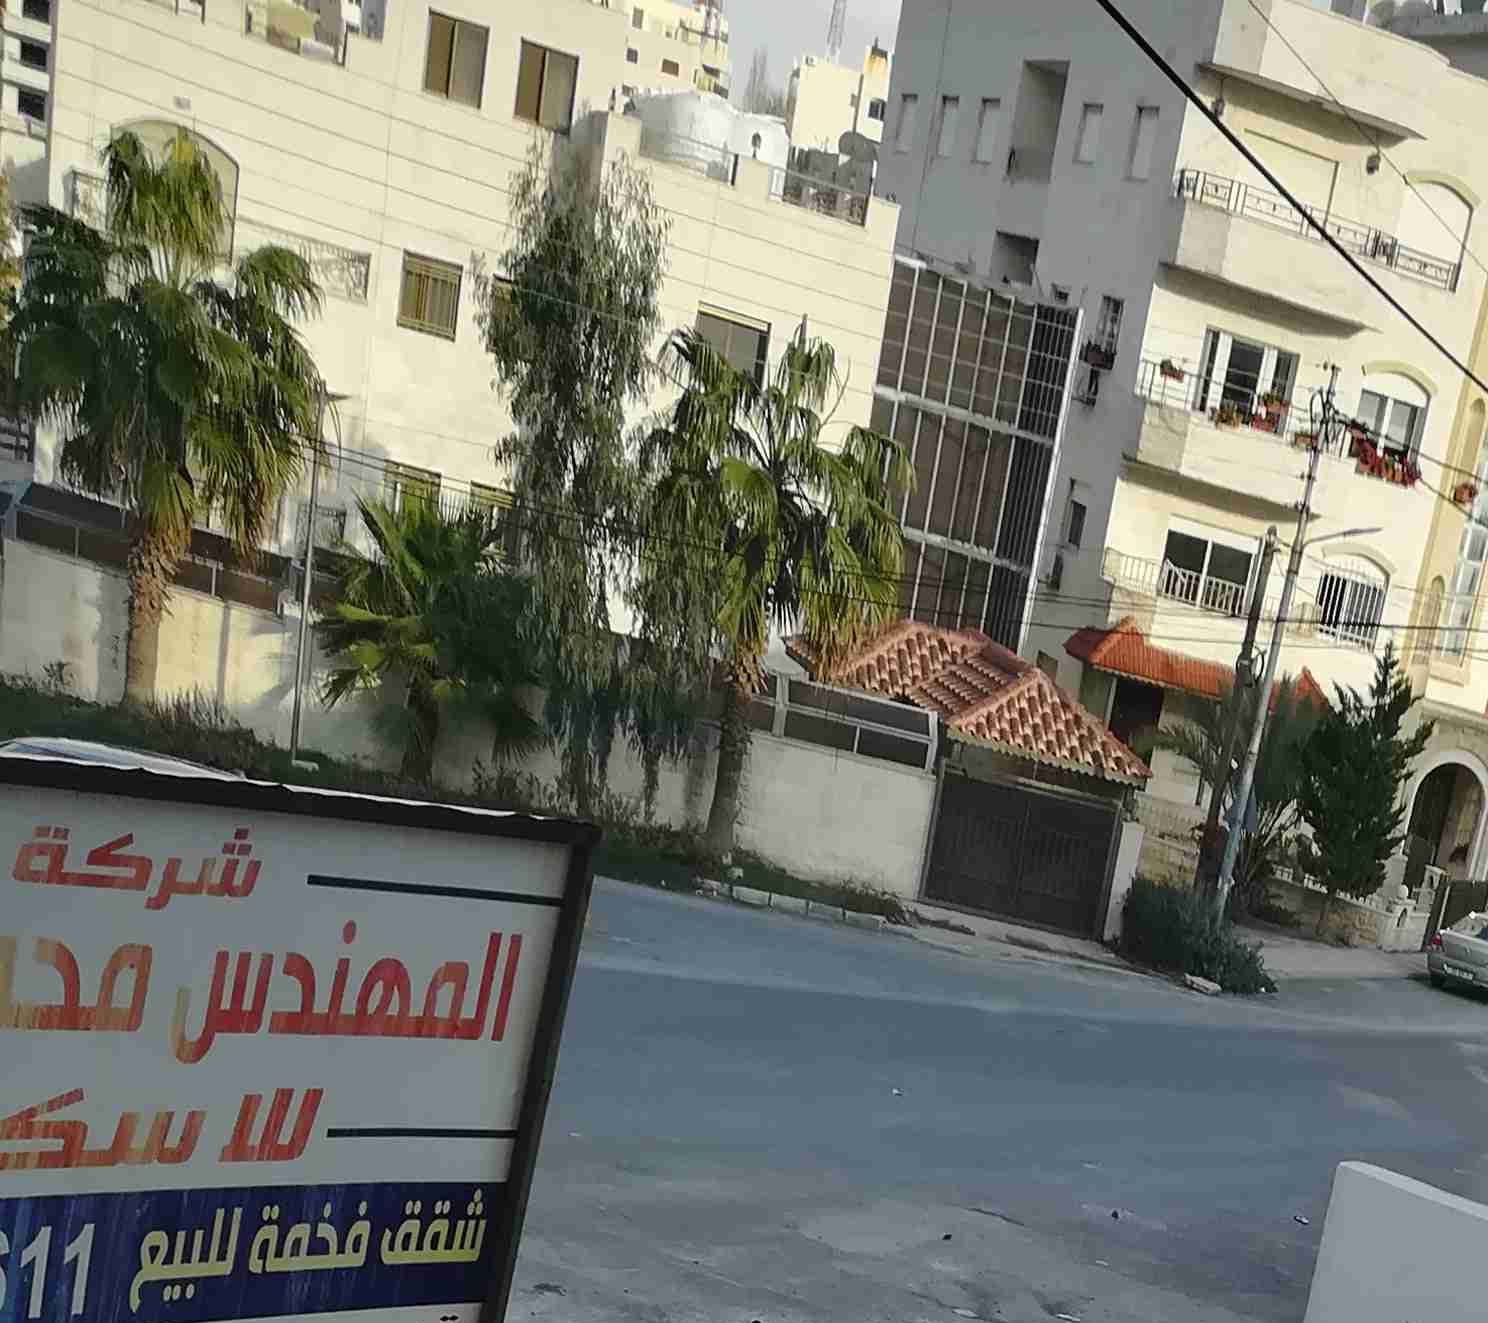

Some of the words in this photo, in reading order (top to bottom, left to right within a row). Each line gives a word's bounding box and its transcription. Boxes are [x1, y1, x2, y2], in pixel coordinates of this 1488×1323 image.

[12, 825, 263, 911] شركة
[171, 919, 523, 1064] المهندس
[129, 1207, 243, 1313] للبيع
[249, 1200, 371, 1274] فخمة
[381, 1188, 488, 1265] شقق
